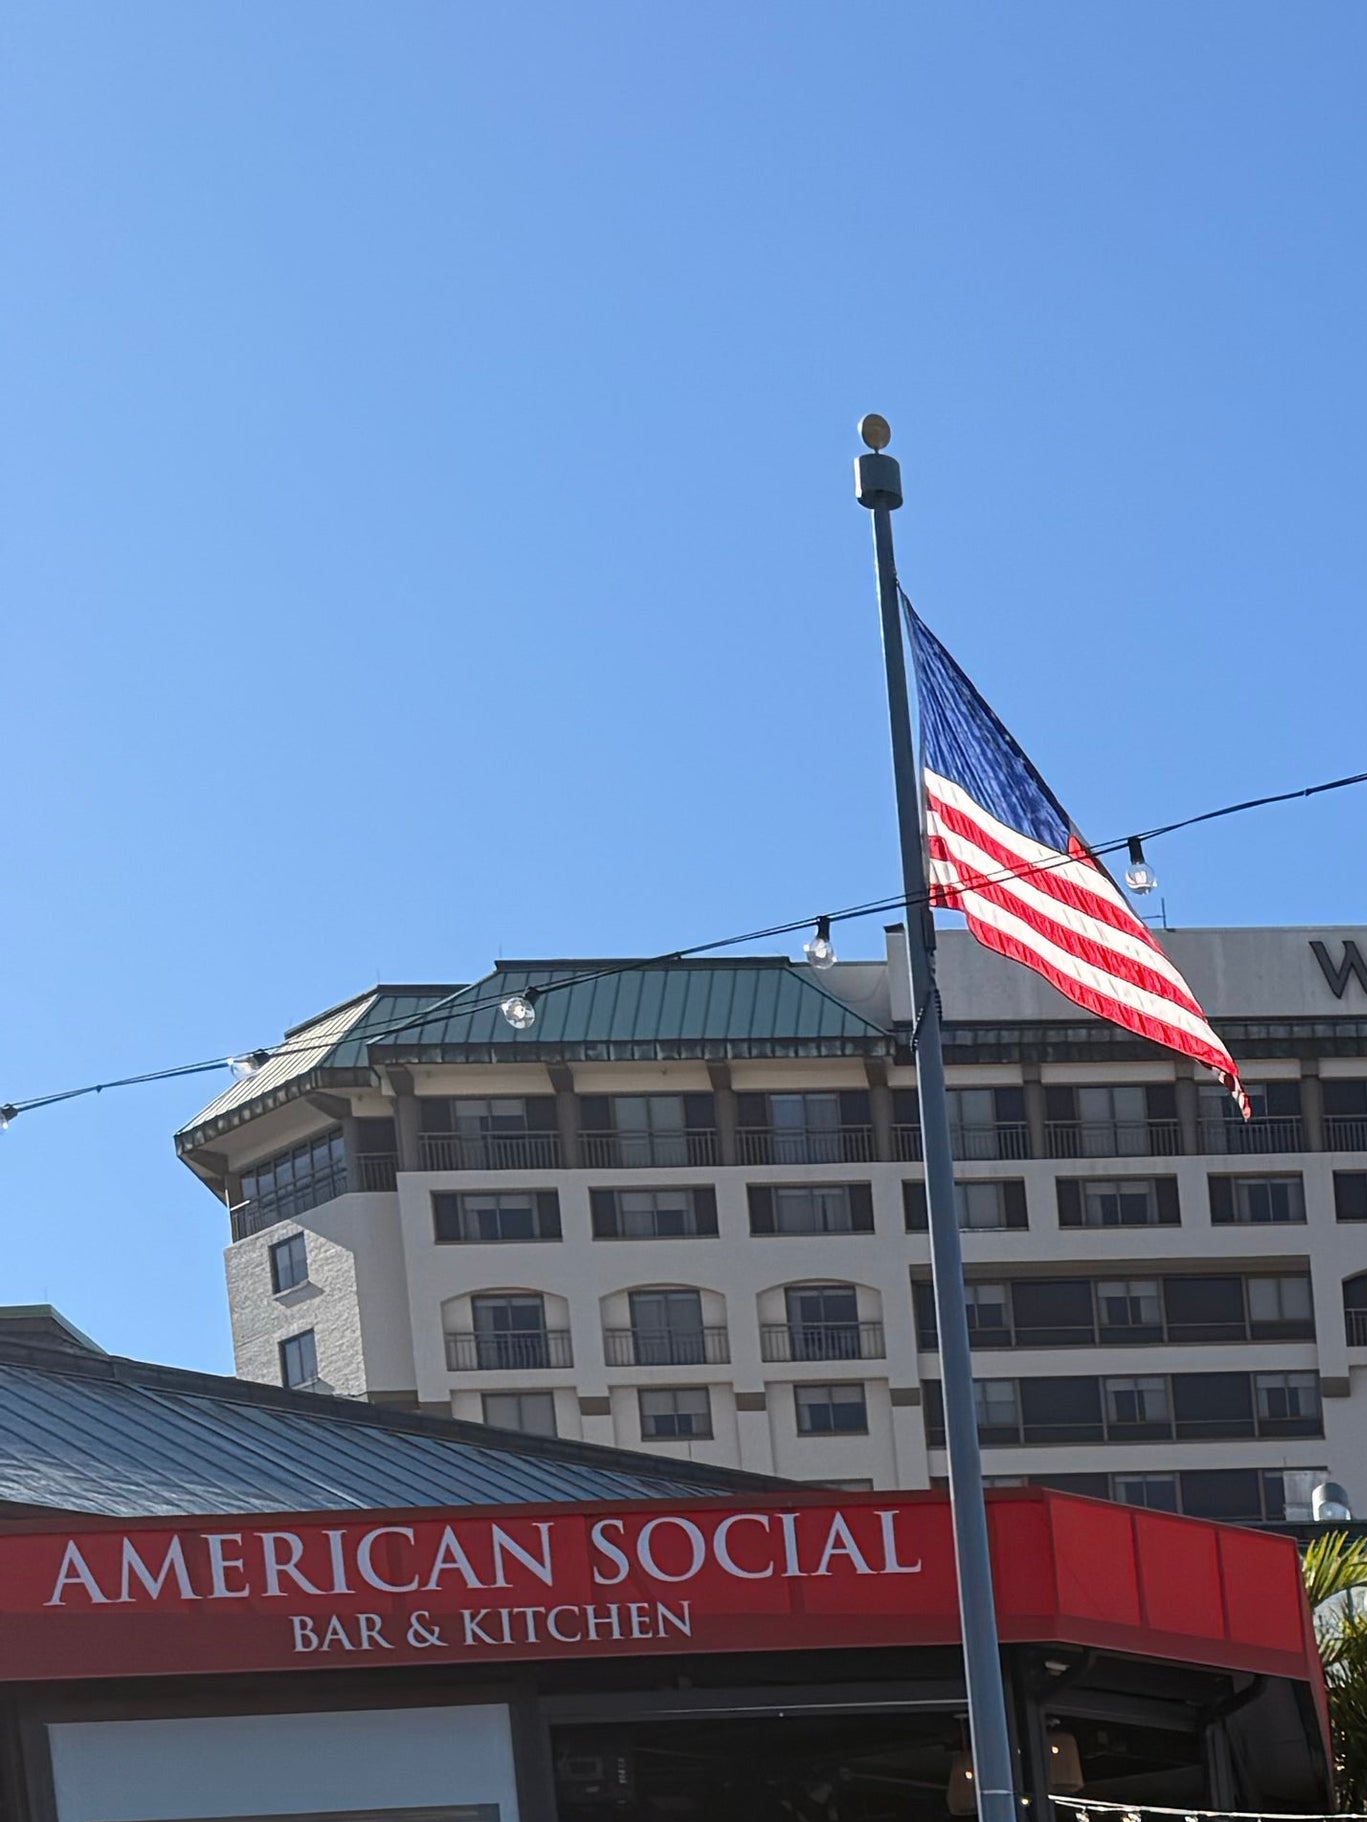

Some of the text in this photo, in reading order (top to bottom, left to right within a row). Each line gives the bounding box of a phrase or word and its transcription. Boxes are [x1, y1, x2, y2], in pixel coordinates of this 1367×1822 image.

[42, 1510, 922, 1607] AMERICAN SOCIAL
[289, 1601, 693, 1653] BAR & KITCHEN
